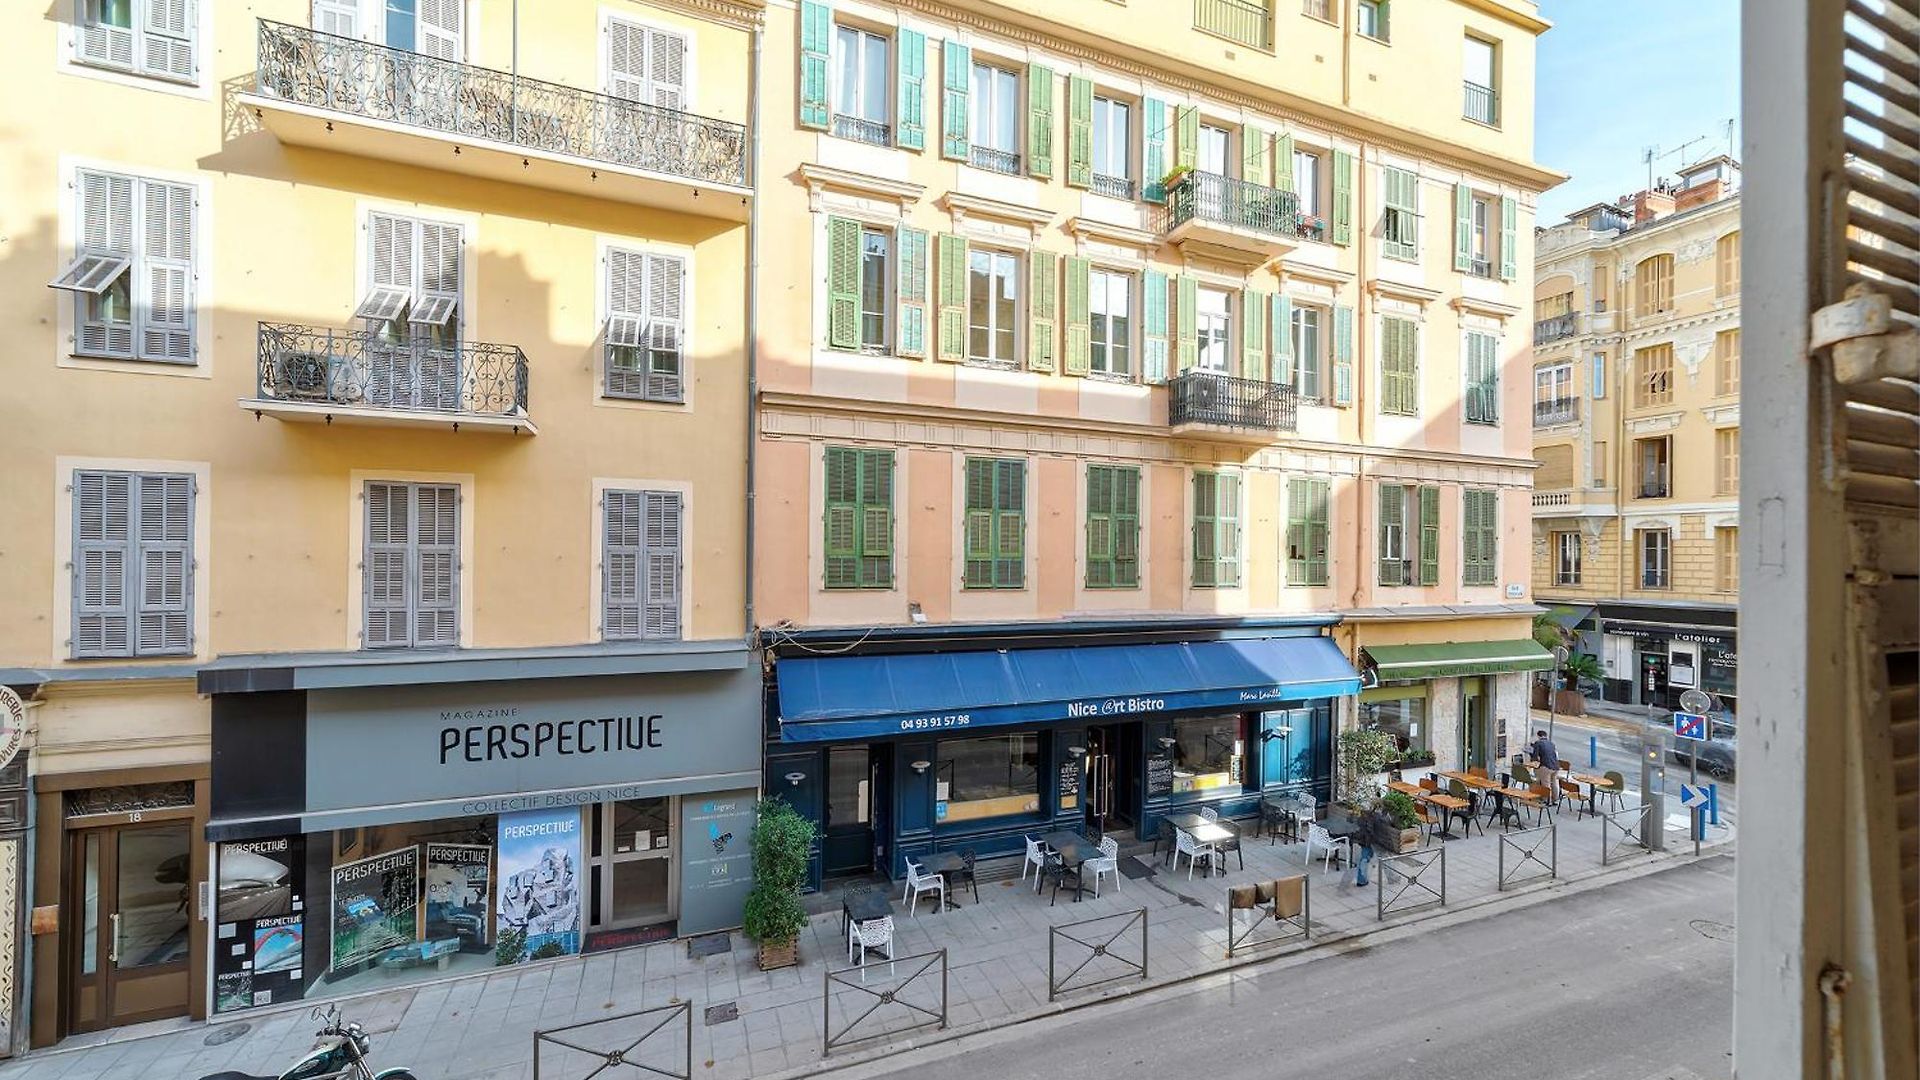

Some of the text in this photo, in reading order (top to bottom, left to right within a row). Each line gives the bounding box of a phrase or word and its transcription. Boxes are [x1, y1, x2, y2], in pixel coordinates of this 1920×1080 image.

[1674, 633, 1720, 643] L'atelier
[440, 708, 518, 720] MAGAZINE
[1068, 702, 1097, 717] Nice
[1128, 698, 1164, 712] Bistro
[901, 714, 970, 729] 04 93 91 57 98
[462, 787, 640, 814] COLLECTIF DESIGN NICE
[130, 812, 141, 823] 18
